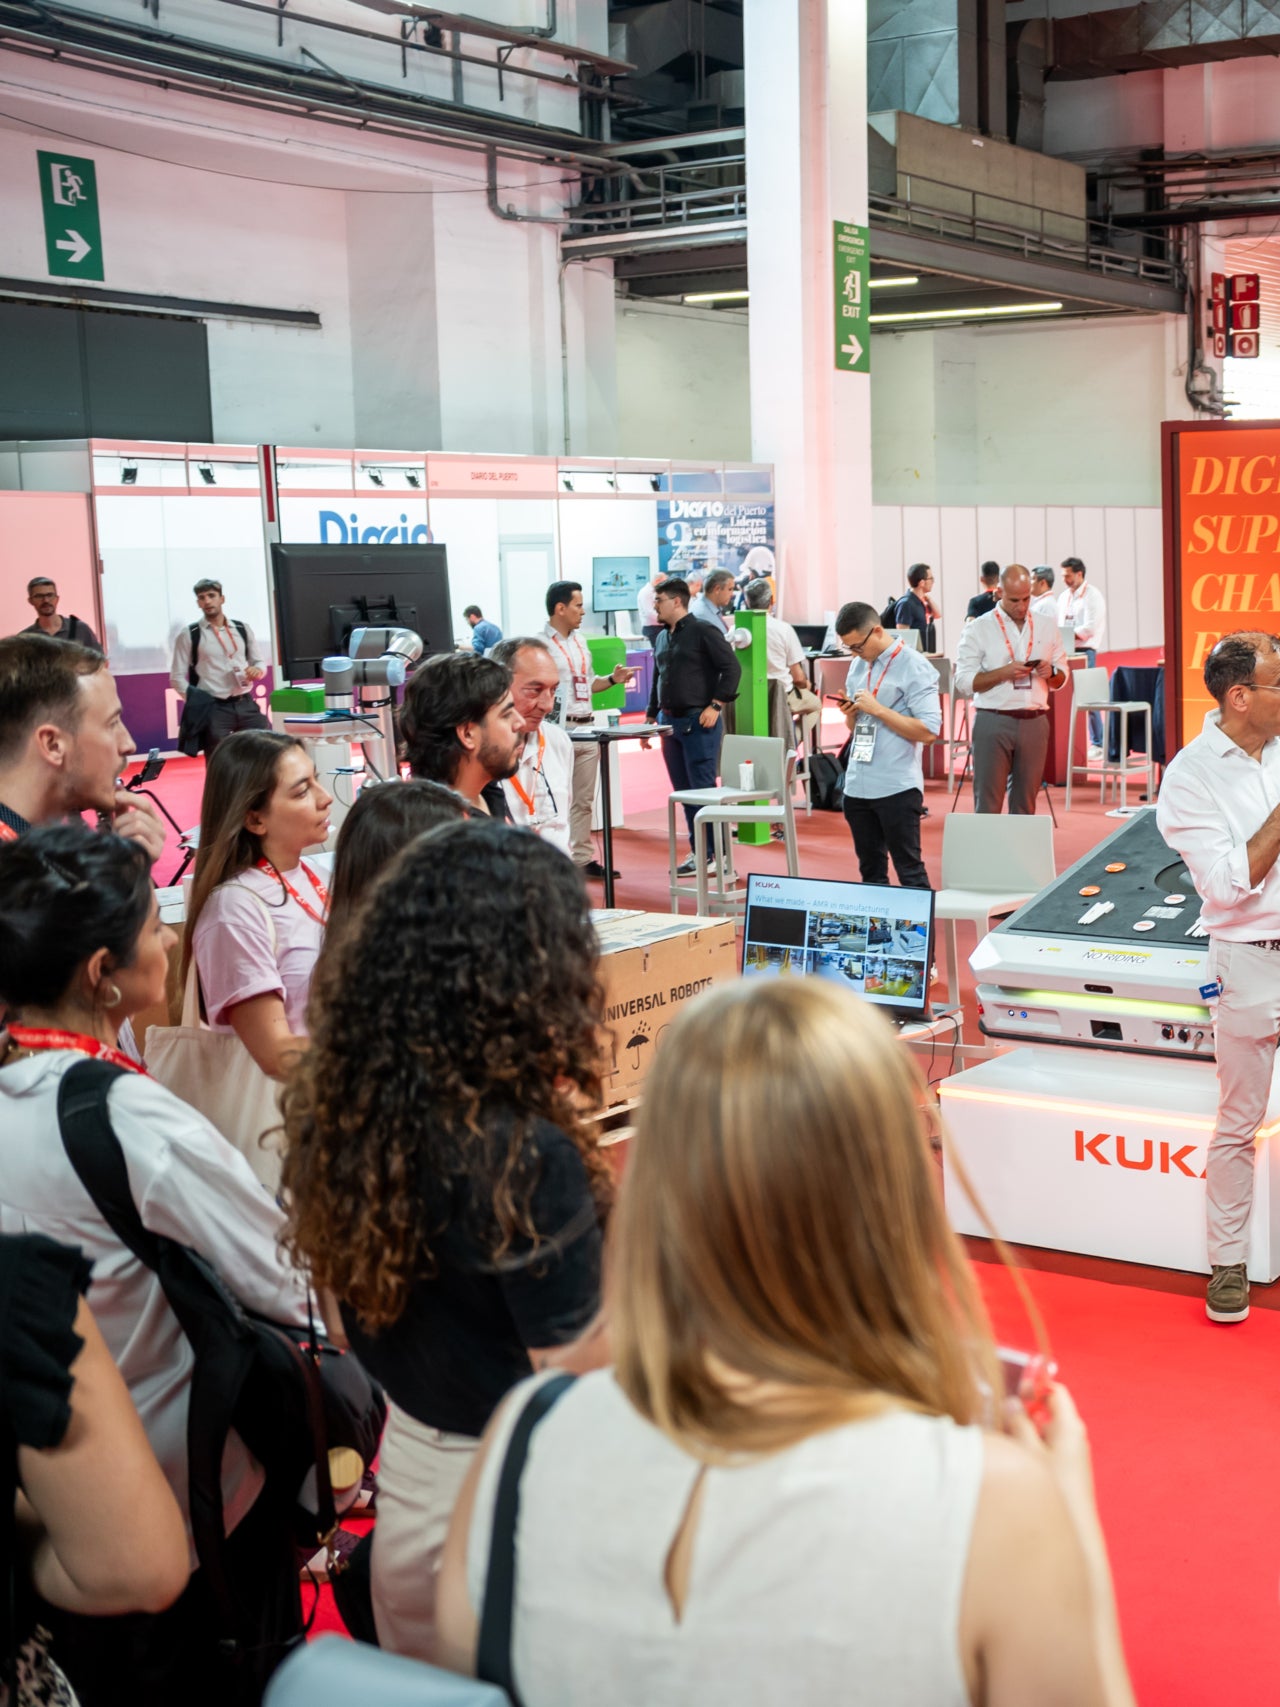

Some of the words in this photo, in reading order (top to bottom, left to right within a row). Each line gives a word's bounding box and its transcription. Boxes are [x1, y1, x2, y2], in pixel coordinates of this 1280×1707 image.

[842, 304, 861, 318] EXIT
[755, 881, 781, 890] KUKA
[755, 894, 773, 905] What
[785, 897, 805, 906] made
[812, 900, 829, 908] AMR
[830, 901, 838, 909] in
[838, 902, 890, 914] manufacturing
[1082, 951, 1103, 960] NO
[1103, 953, 1147, 964] RIDING
[601, 991, 666, 1025] UNIVERSAL
[1074, 1129, 1207, 1180] KUK
